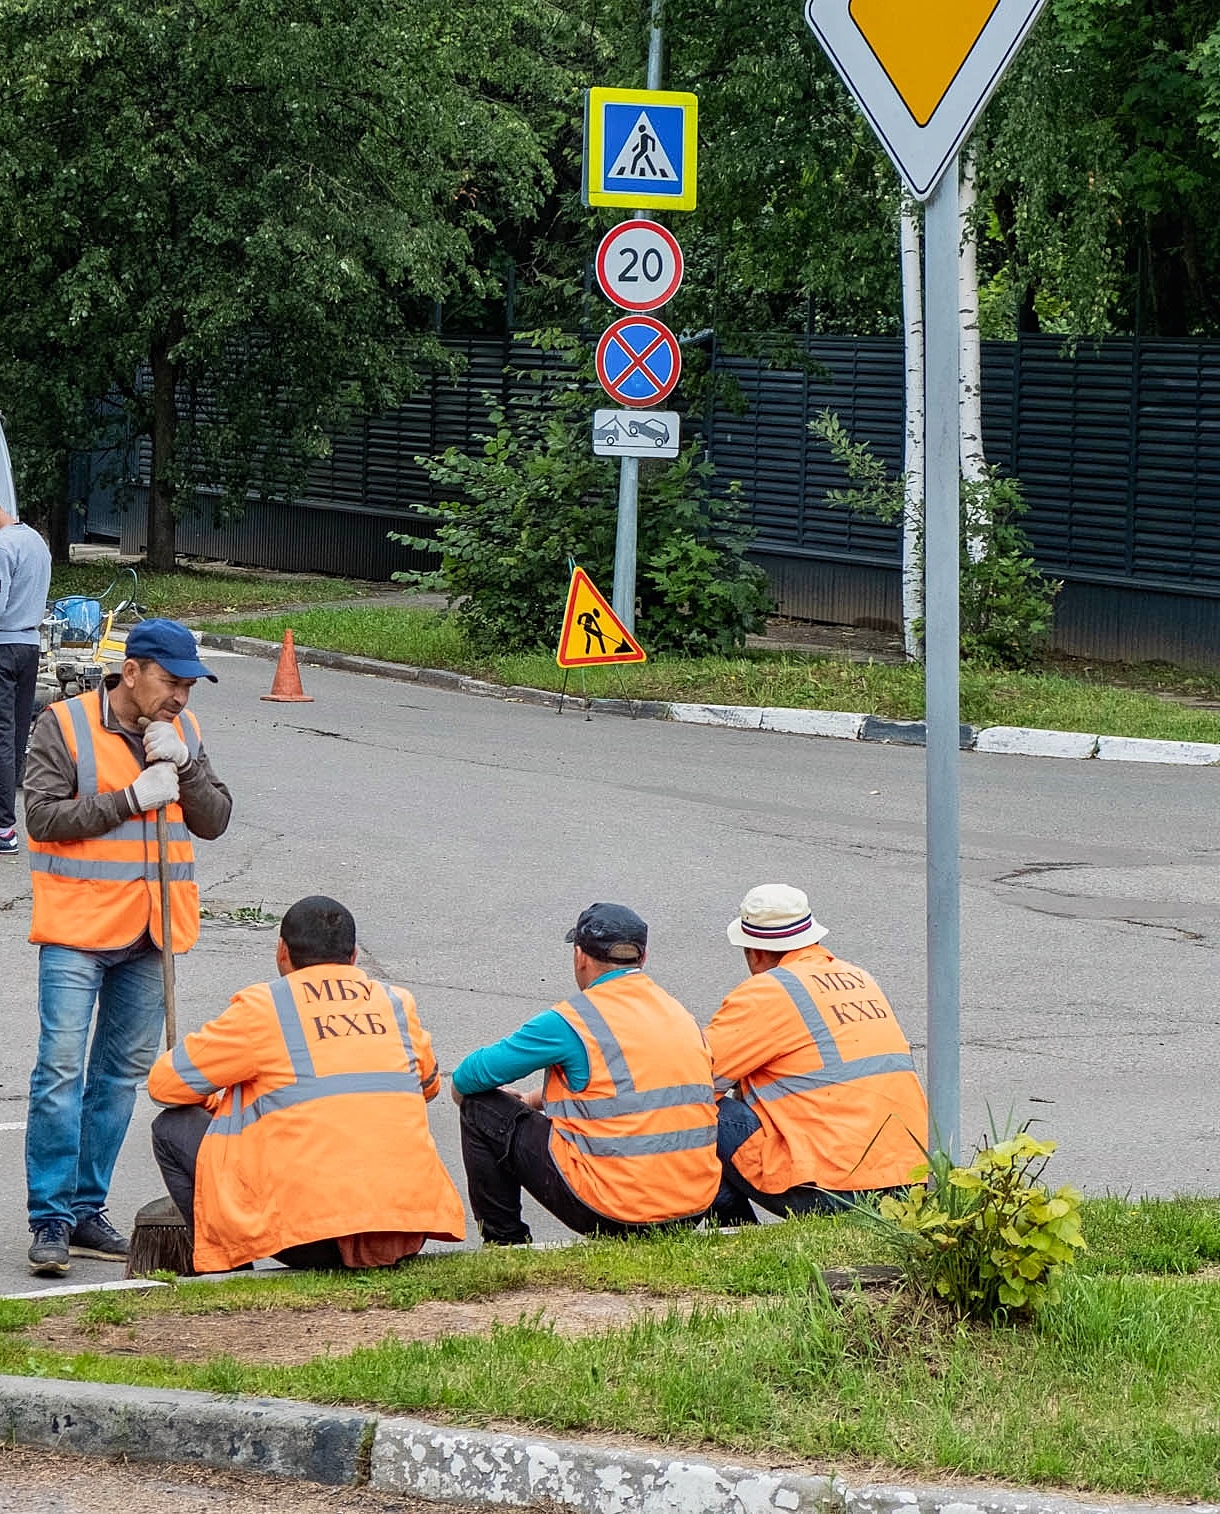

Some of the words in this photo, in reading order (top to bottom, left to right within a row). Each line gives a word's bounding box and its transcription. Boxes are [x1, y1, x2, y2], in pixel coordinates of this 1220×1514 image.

[618, 247, 663, 282] 20
[301, 979, 373, 1003] МБУ
[808, 971, 866, 994] МБУ
[828, 999, 887, 1026] КХБ
[313, 1013, 387, 1040] КХБ
